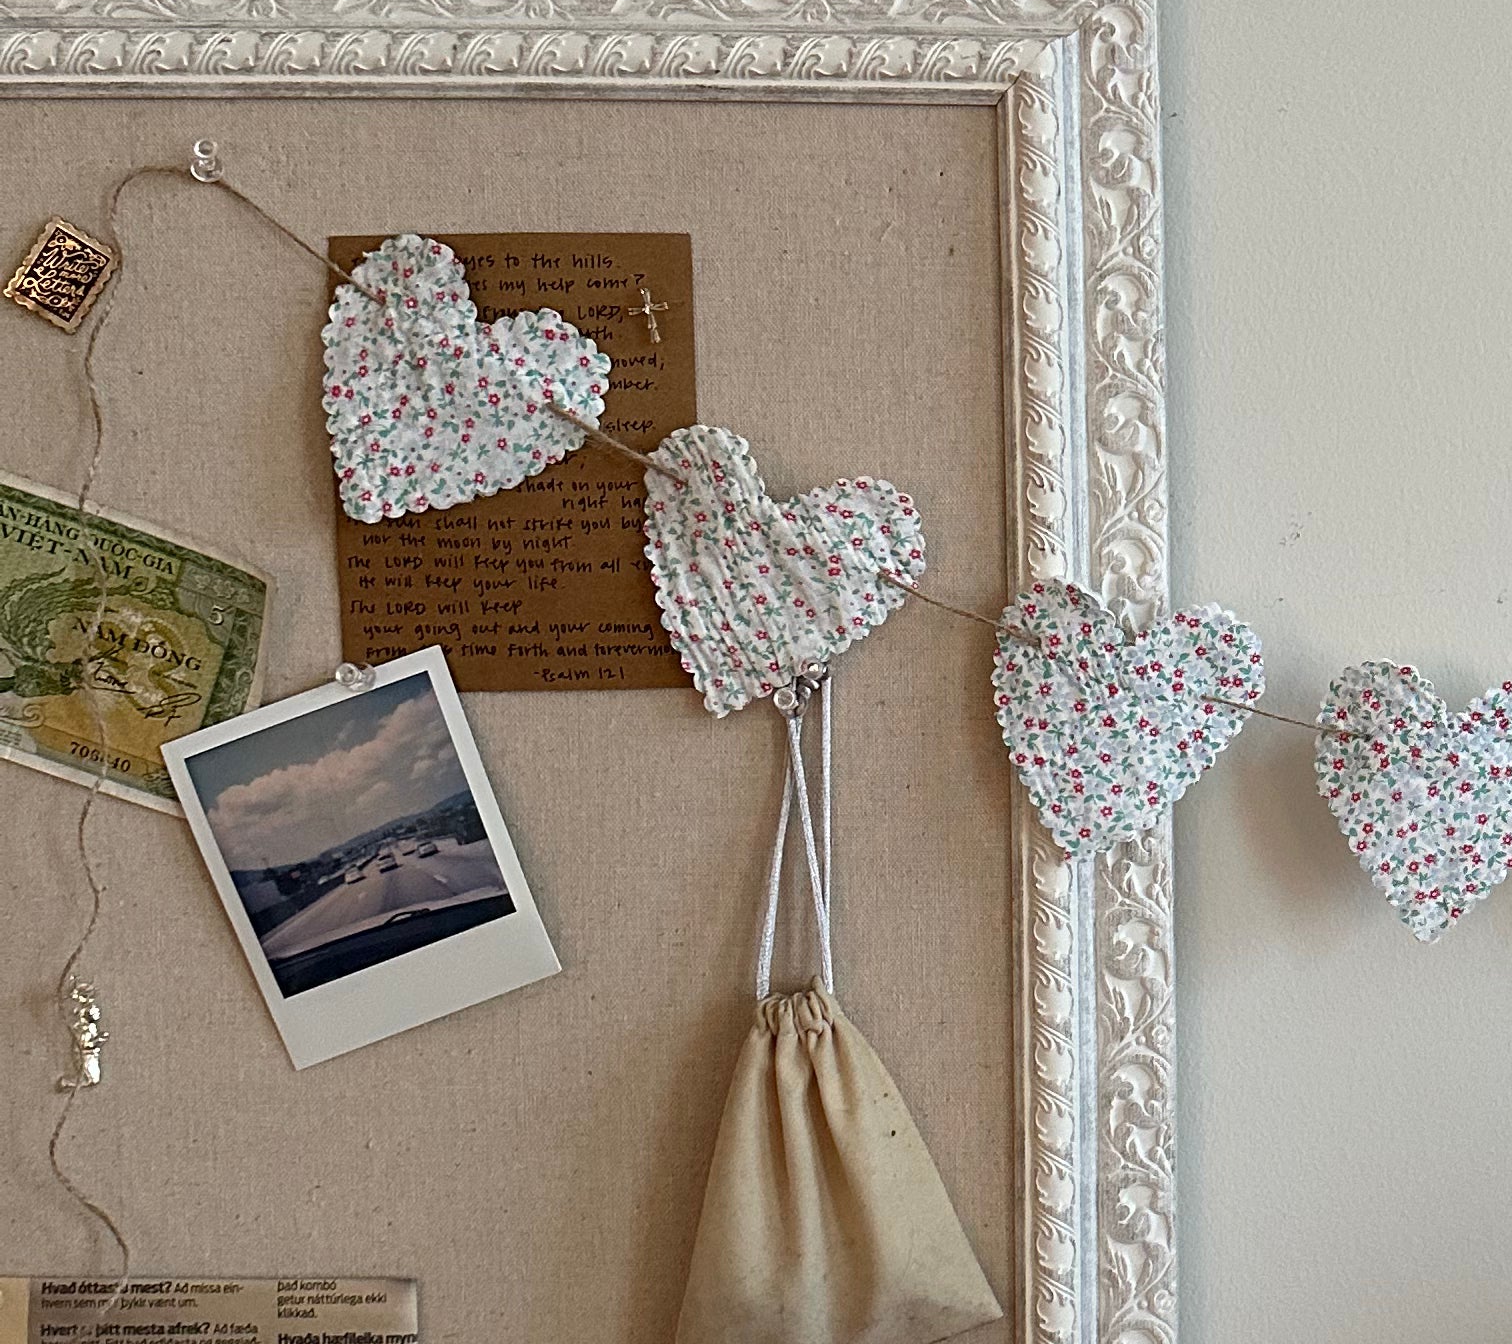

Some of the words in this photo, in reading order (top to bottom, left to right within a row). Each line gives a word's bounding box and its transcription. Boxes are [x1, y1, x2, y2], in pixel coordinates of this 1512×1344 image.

[43, 248, 99, 273] Write
[504, 253, 520, 269] to
[531, 254, 561, 269] the
[500, 278, 526, 295] my
[537, 277, 575, 293] help
[517, 478, 564, 493] shade
[572, 481, 590, 493] on
[596, 481, 638, 498] your
[562, 494, 609, 512] right
[621, 496, 645, 509] ha
[435, 515, 477, 530] shall
[487, 516, 516, 531] not
[523, 515, 573, 530] strike
[580, 517, 611, 535] you
[621, 516, 643, 533] by
[363, 534, 391, 547] nor
[399, 533, 426, 547] the
[437, 536, 481, 549] moon
[491, 536, 512, 555] by
[347, 556, 371, 569] The
[385, 556, 423, 570] LORD
[434, 554, 464, 568] will
[516, 557, 545, 574] you
[550, 558, 592, 573] from
[599, 557, 621, 573] all
[359, 575, 376, 589] He
[385, 573, 413, 588] will
[473, 577, 517, 597] your
[208, 605, 225, 626] 5
[350, 599, 376, 614] The
[386, 601, 426, 615] LORD
[437, 599, 470, 615] will
[363, 625, 404, 641] your
[414, 623, 462, 641] going
[472, 621, 502, 636] out
[508, 620, 541, 635] and
[550, 622, 591, 642] your
[598, 623, 655, 642] coming
[461, 642, 498, 657] time
[556, 643, 588, 658] and
[599, 666, 626, 680] 121
